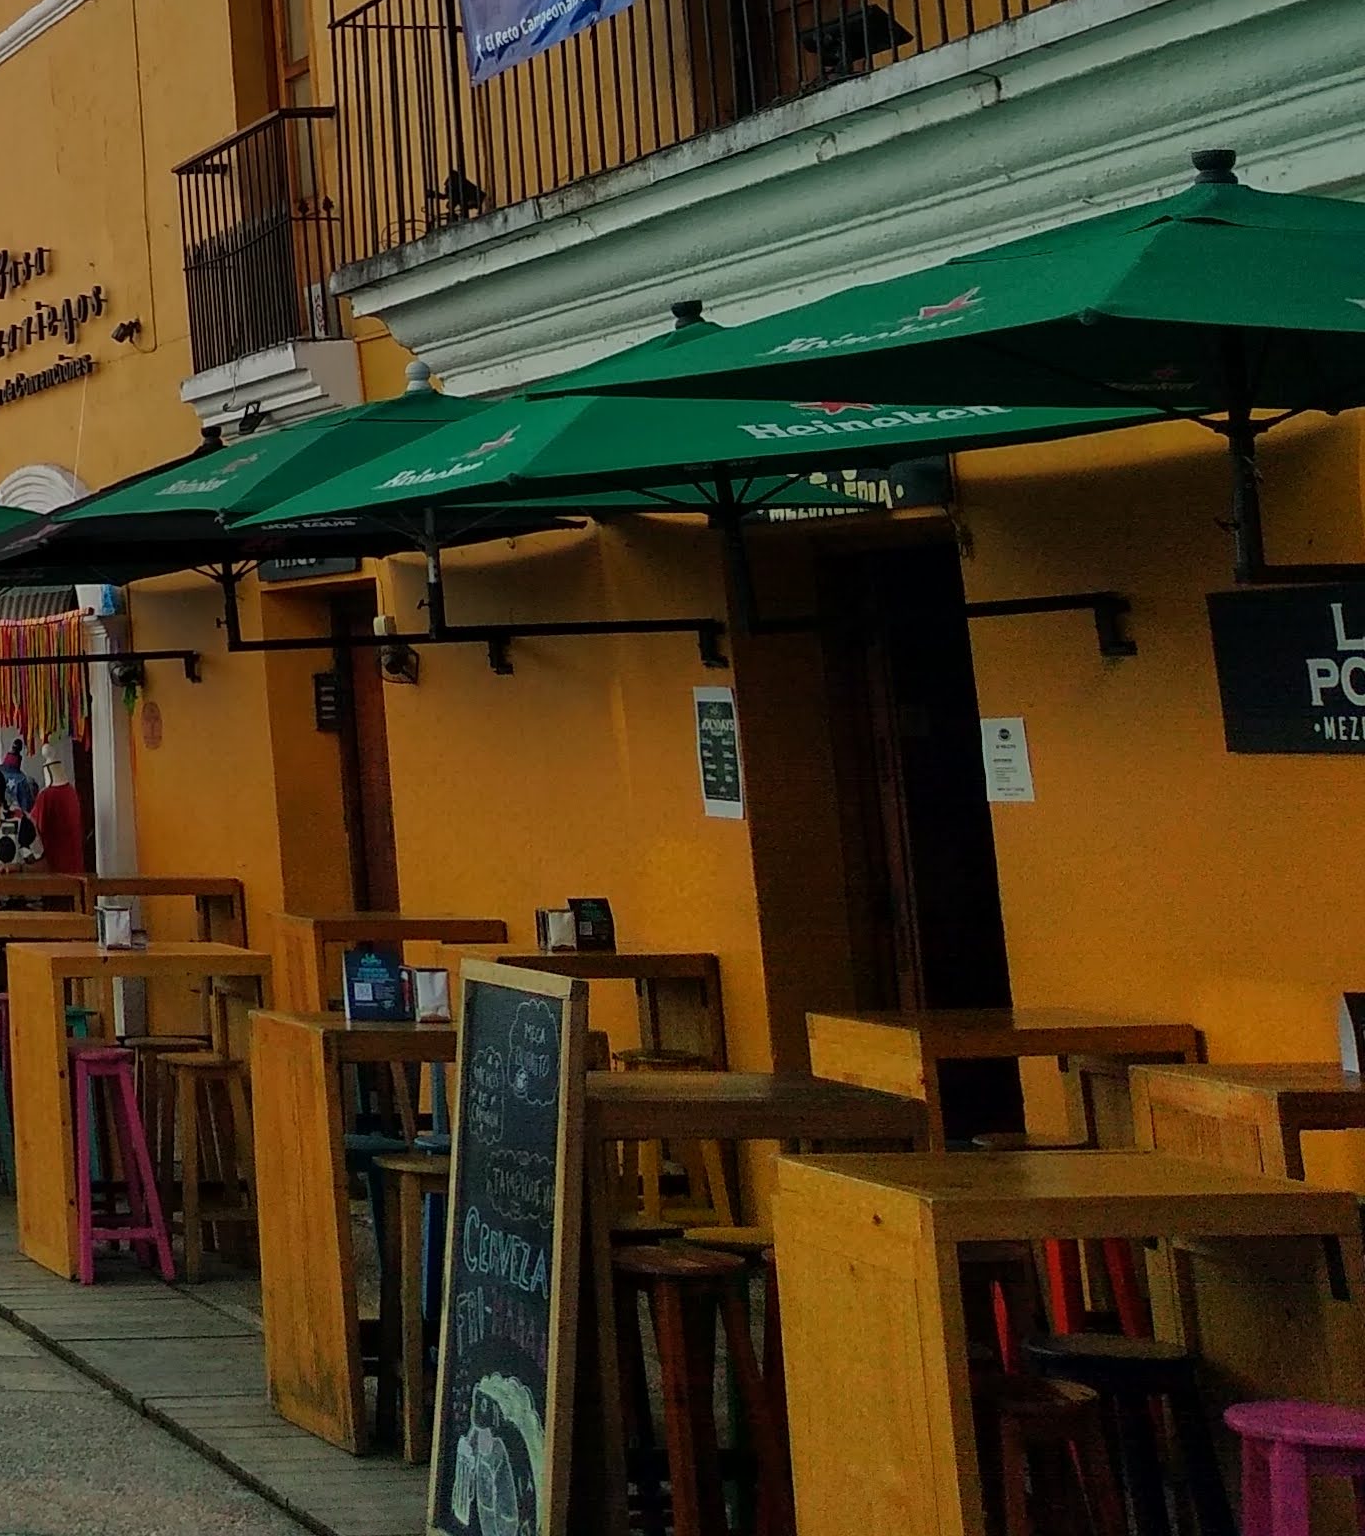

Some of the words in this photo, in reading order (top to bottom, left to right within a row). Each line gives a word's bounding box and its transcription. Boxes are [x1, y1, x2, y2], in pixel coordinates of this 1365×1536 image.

[484, 32, 495, 52] El
[495, 25, 520, 47] Reto
[2, 379, 15, 404] de
[15, 354, 94, 397] Convenciones
[736, 405, 1014, 440] Heineken
[1330, 602, 1365, 652] L
[1305, 656, 1365, 707] PO
[1323, 715, 1365, 741] MEZ
